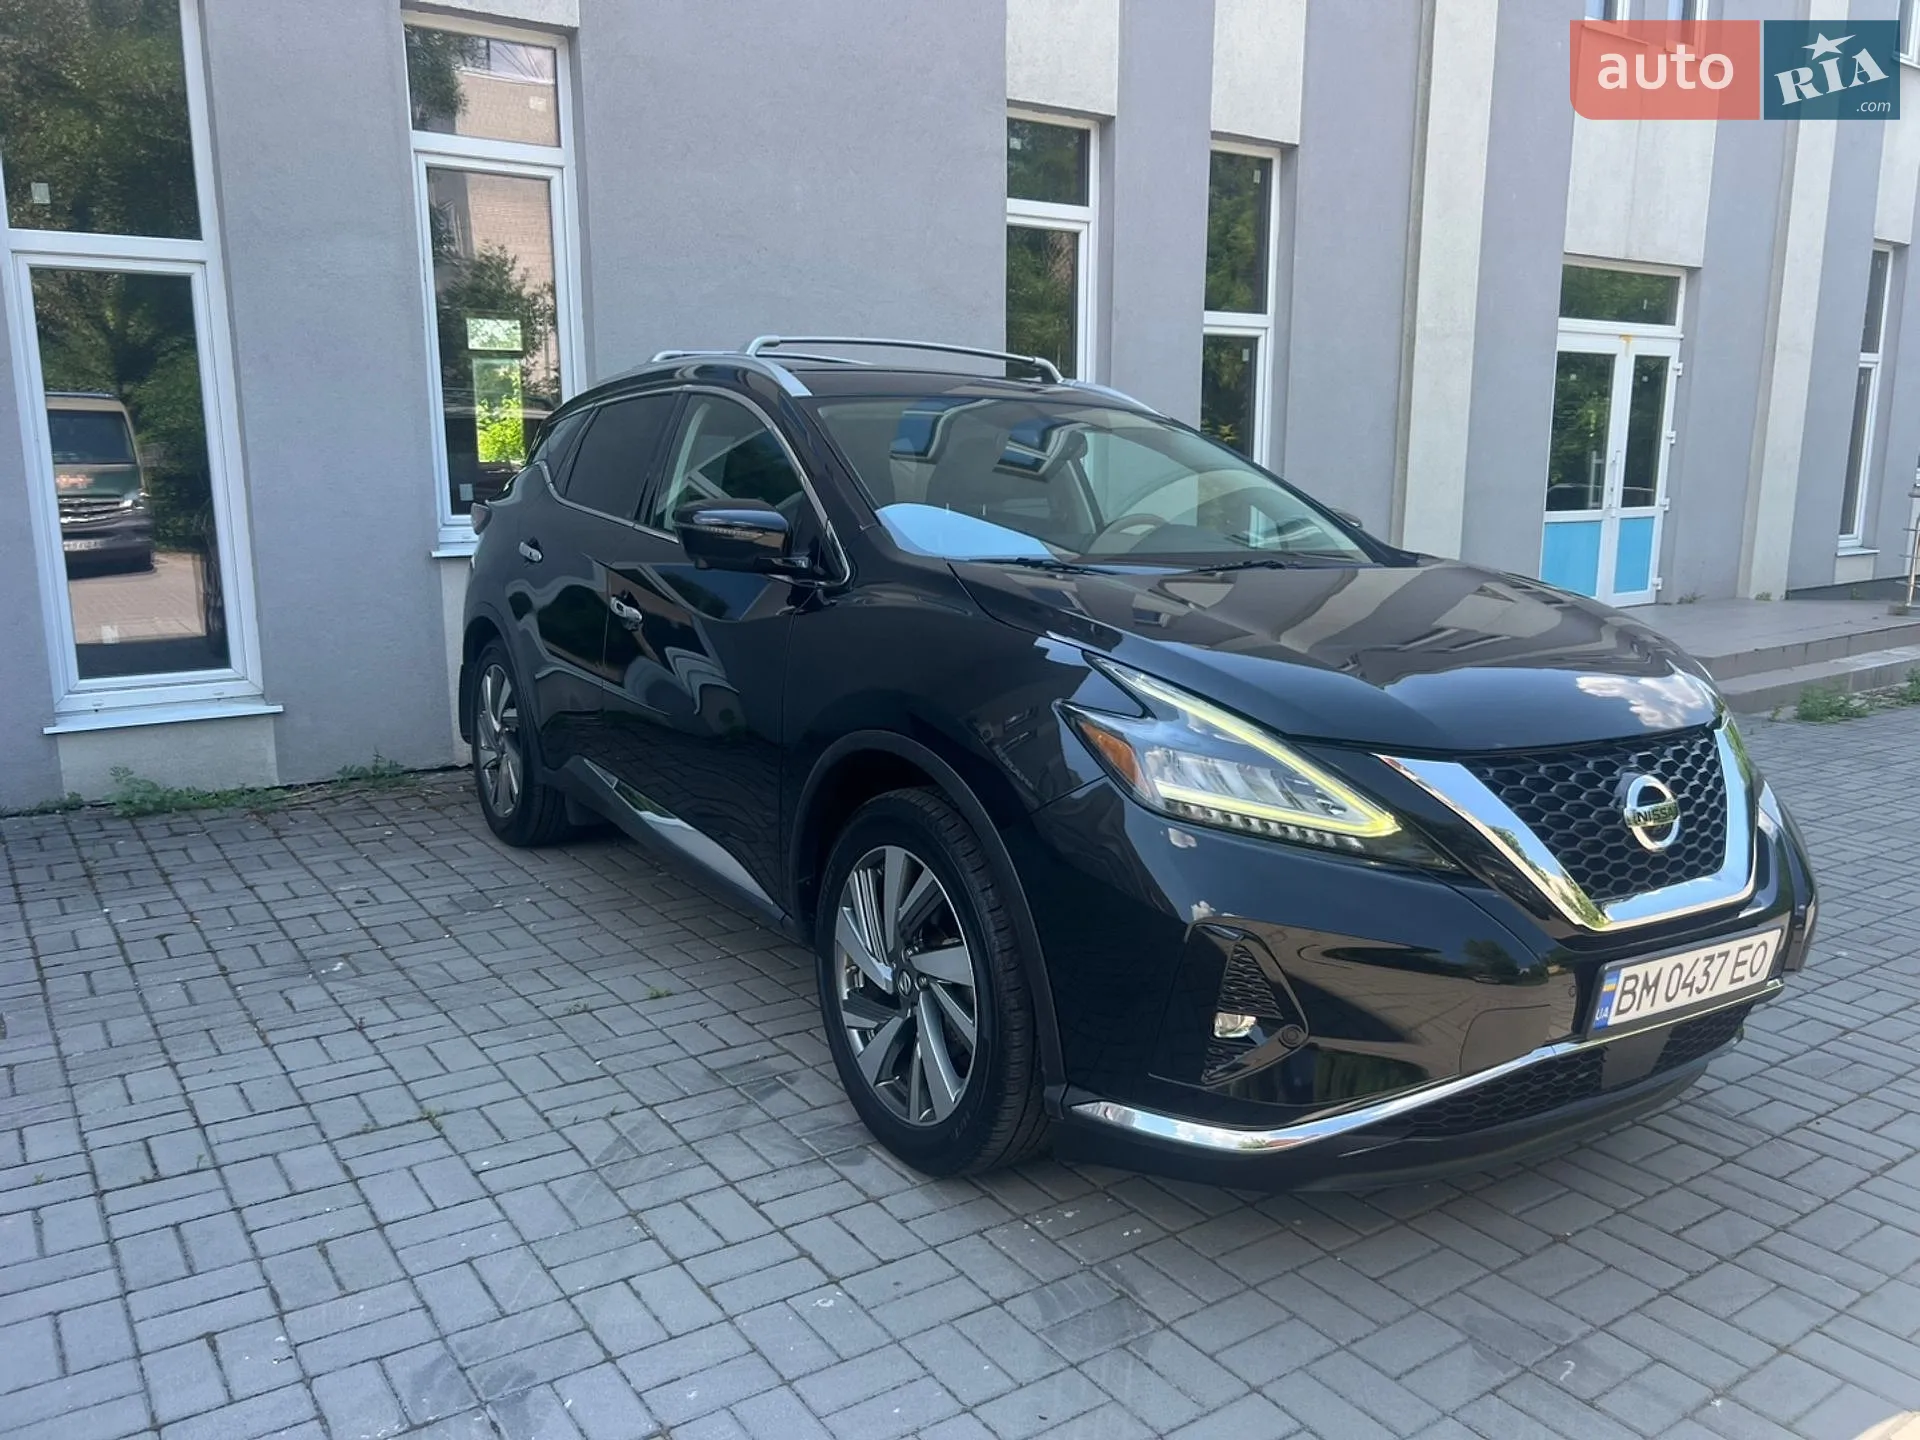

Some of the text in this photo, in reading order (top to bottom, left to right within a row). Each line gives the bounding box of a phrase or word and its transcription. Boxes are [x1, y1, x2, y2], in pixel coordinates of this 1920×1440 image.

[1615, 940, 1768, 1016] BM 0437 EO
